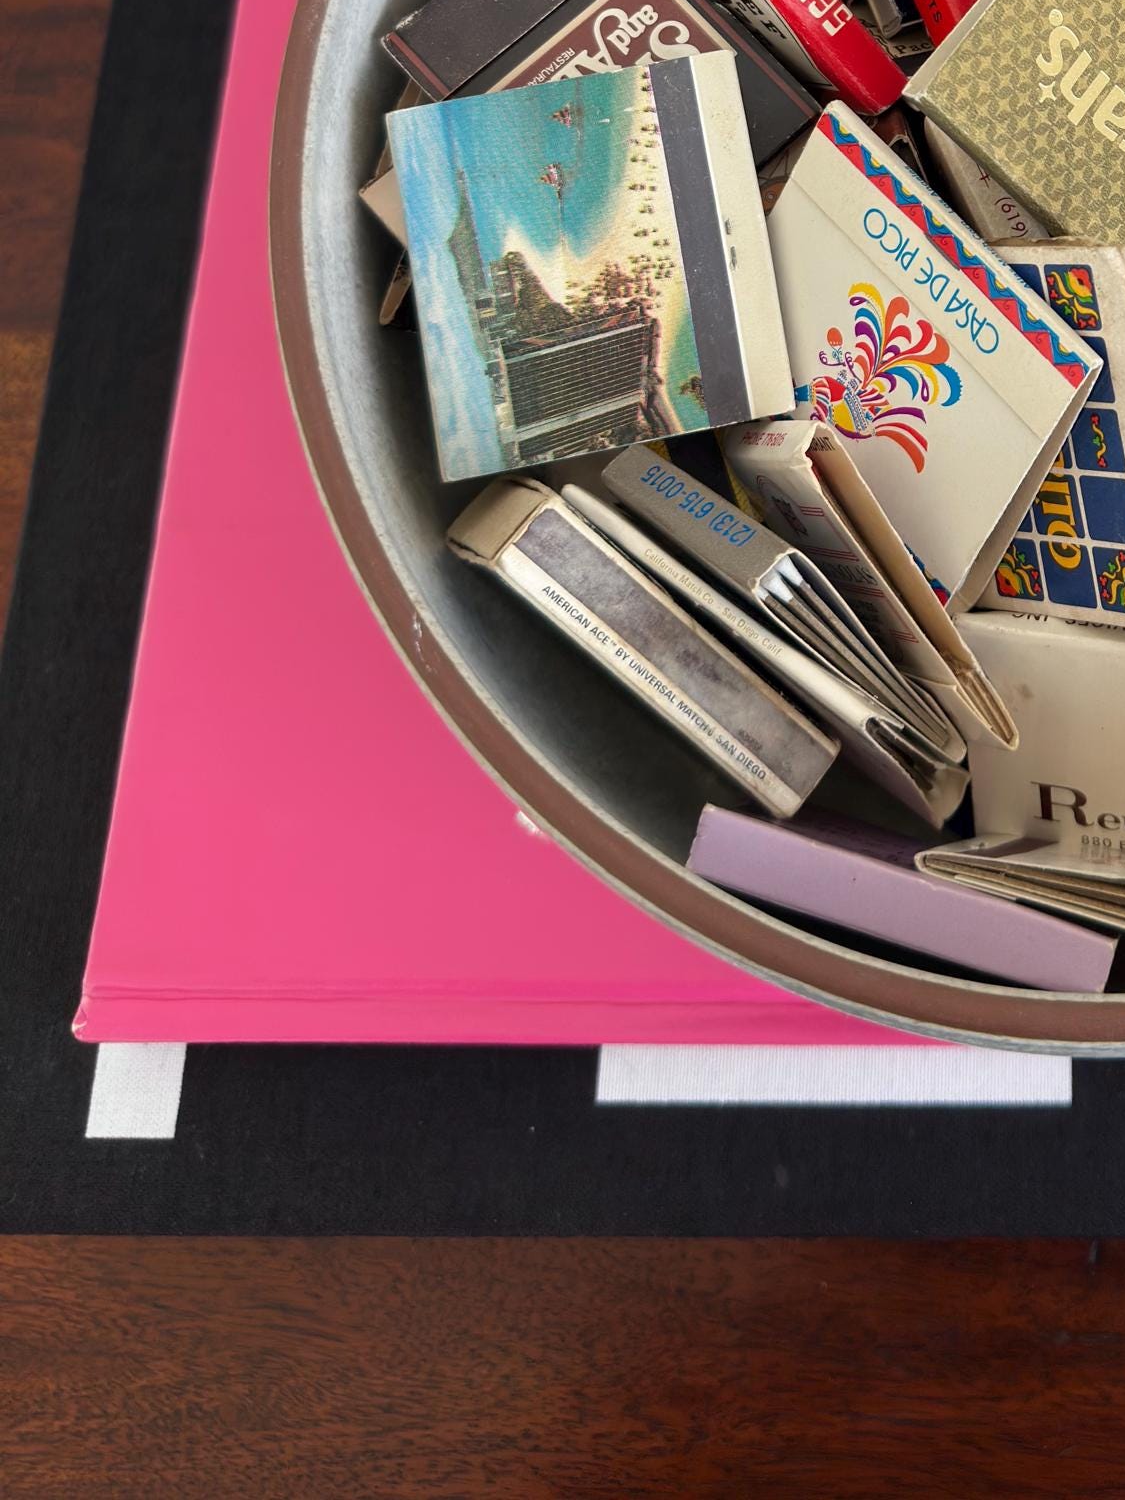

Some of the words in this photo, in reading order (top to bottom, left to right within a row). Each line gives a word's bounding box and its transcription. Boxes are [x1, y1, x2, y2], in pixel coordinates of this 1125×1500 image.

[607, 4, 659, 56] and
[863, 207, 920, 272] PICO
[994, 197, 1029, 238] (619)
[914, 257, 951, 303] DE
[944, 287, 1000, 354] CASA
[640, 464, 716, 519] 615-0015
[708, 511, 756, 547] (213)
[644, 548, 680, 581] California
[721, 607, 738, 624] San
[542, 585, 592, 631] AMERICAN
[614, 647, 630, 664] BY
[627, 658, 678, 705] UNIVERSAL
[677, 699, 709, 733] MATCH
[716, 733, 737, 758] SAN
[737, 751, 768, 781] DIEGO
[1081, 833, 1113, 849] 880
